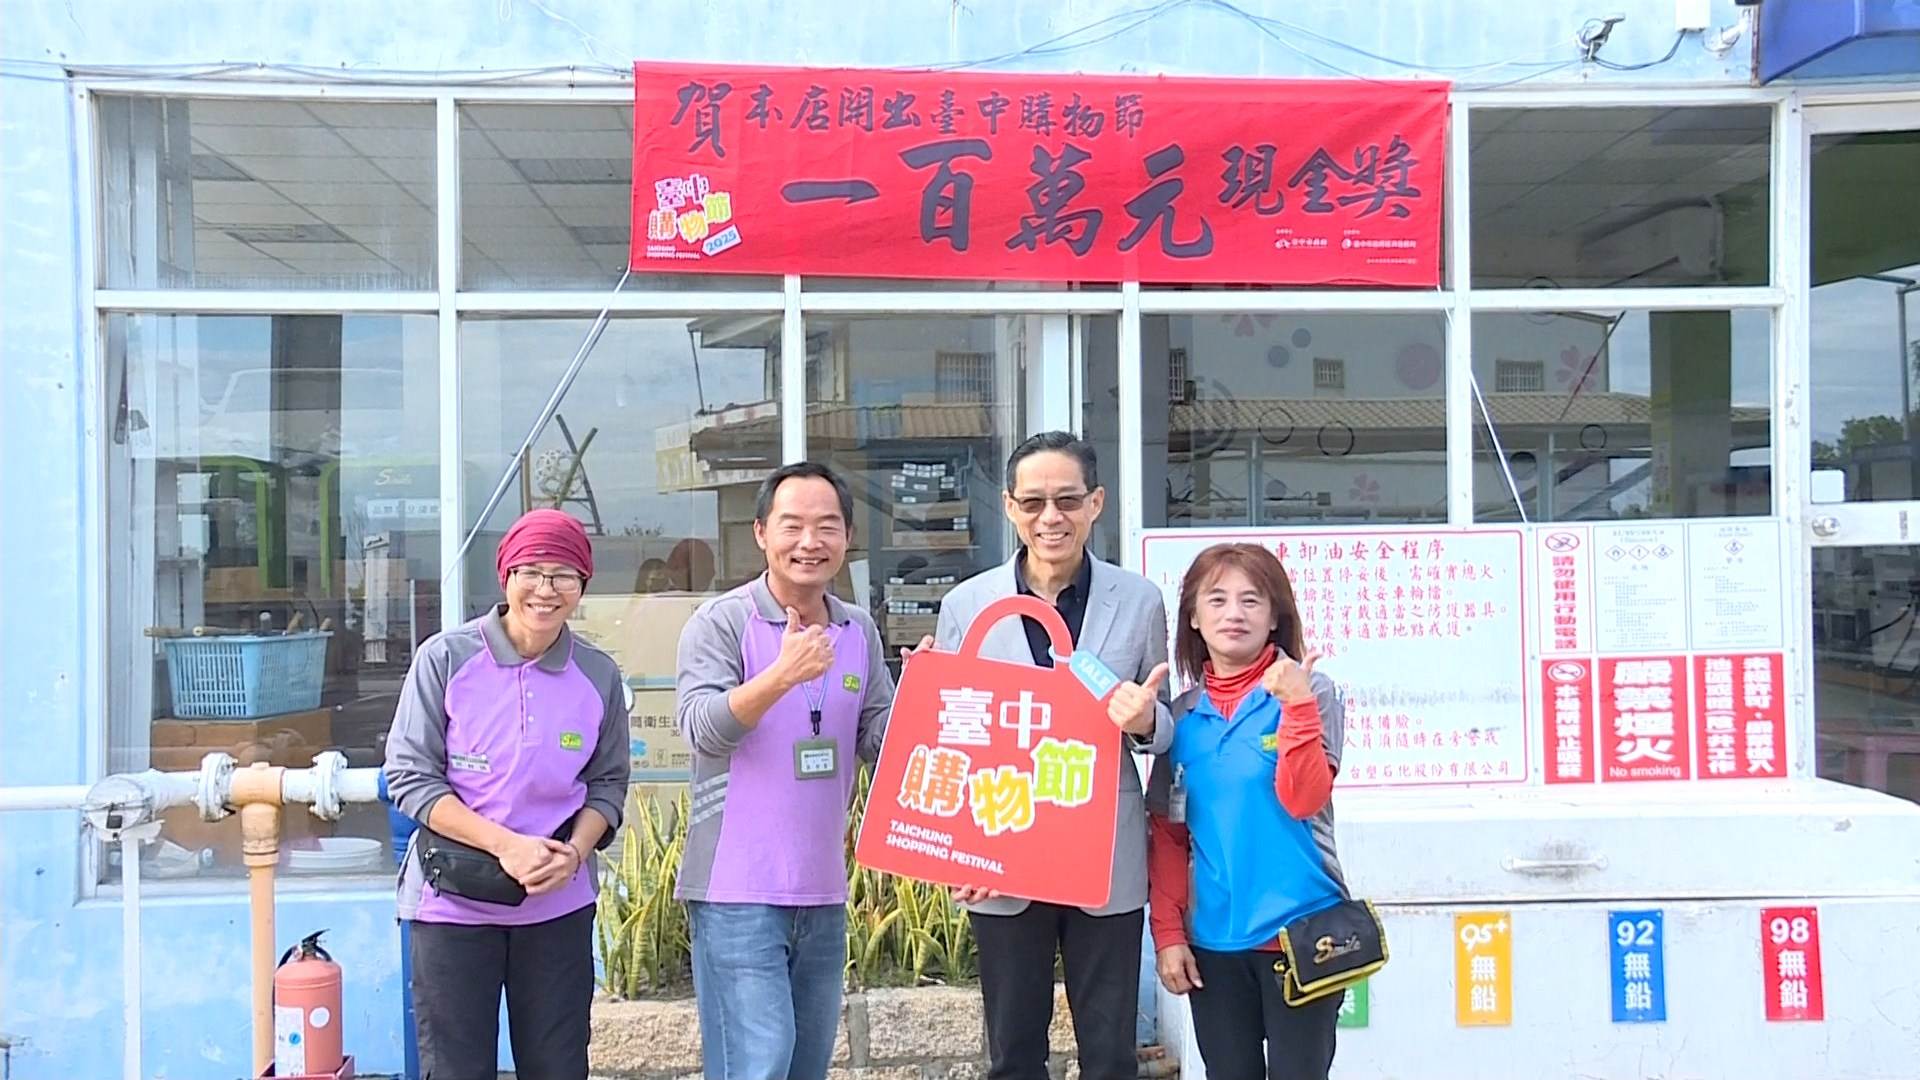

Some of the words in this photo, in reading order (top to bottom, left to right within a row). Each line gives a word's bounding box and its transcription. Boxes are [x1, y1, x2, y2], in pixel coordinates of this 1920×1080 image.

[655, 174, 709, 209] 臺中
[704, 229, 738, 253] 2025
[1259, 540, 1445, 562] 車卸油安全程序
[1552, 556, 1577, 649] 請勿使用行動電話
[1078, 656, 1113, 691] SALE
[938, 687, 1051, 748] 臺中
[897, 736, 1097, 836] 購物節
[1350, 760, 1509, 780] 台塑石化股份有限公司
[1609, 766, 1629, 777] No
[1630, 765, 1682, 778] smoking
[889, 820, 953, 845] TAICHUNG
[886, 834, 949, 860] SHOPPING
[951, 849, 1005, 875] FESTIVAL
[1616, 919, 1655, 946] 92
[1770, 917, 1810, 944] 98
[1470, 955, 1496, 1012] 無鉛
[1624, 951, 1652, 1010] 無鉛
[1778, 949, 1808, 1008] 無鉛
